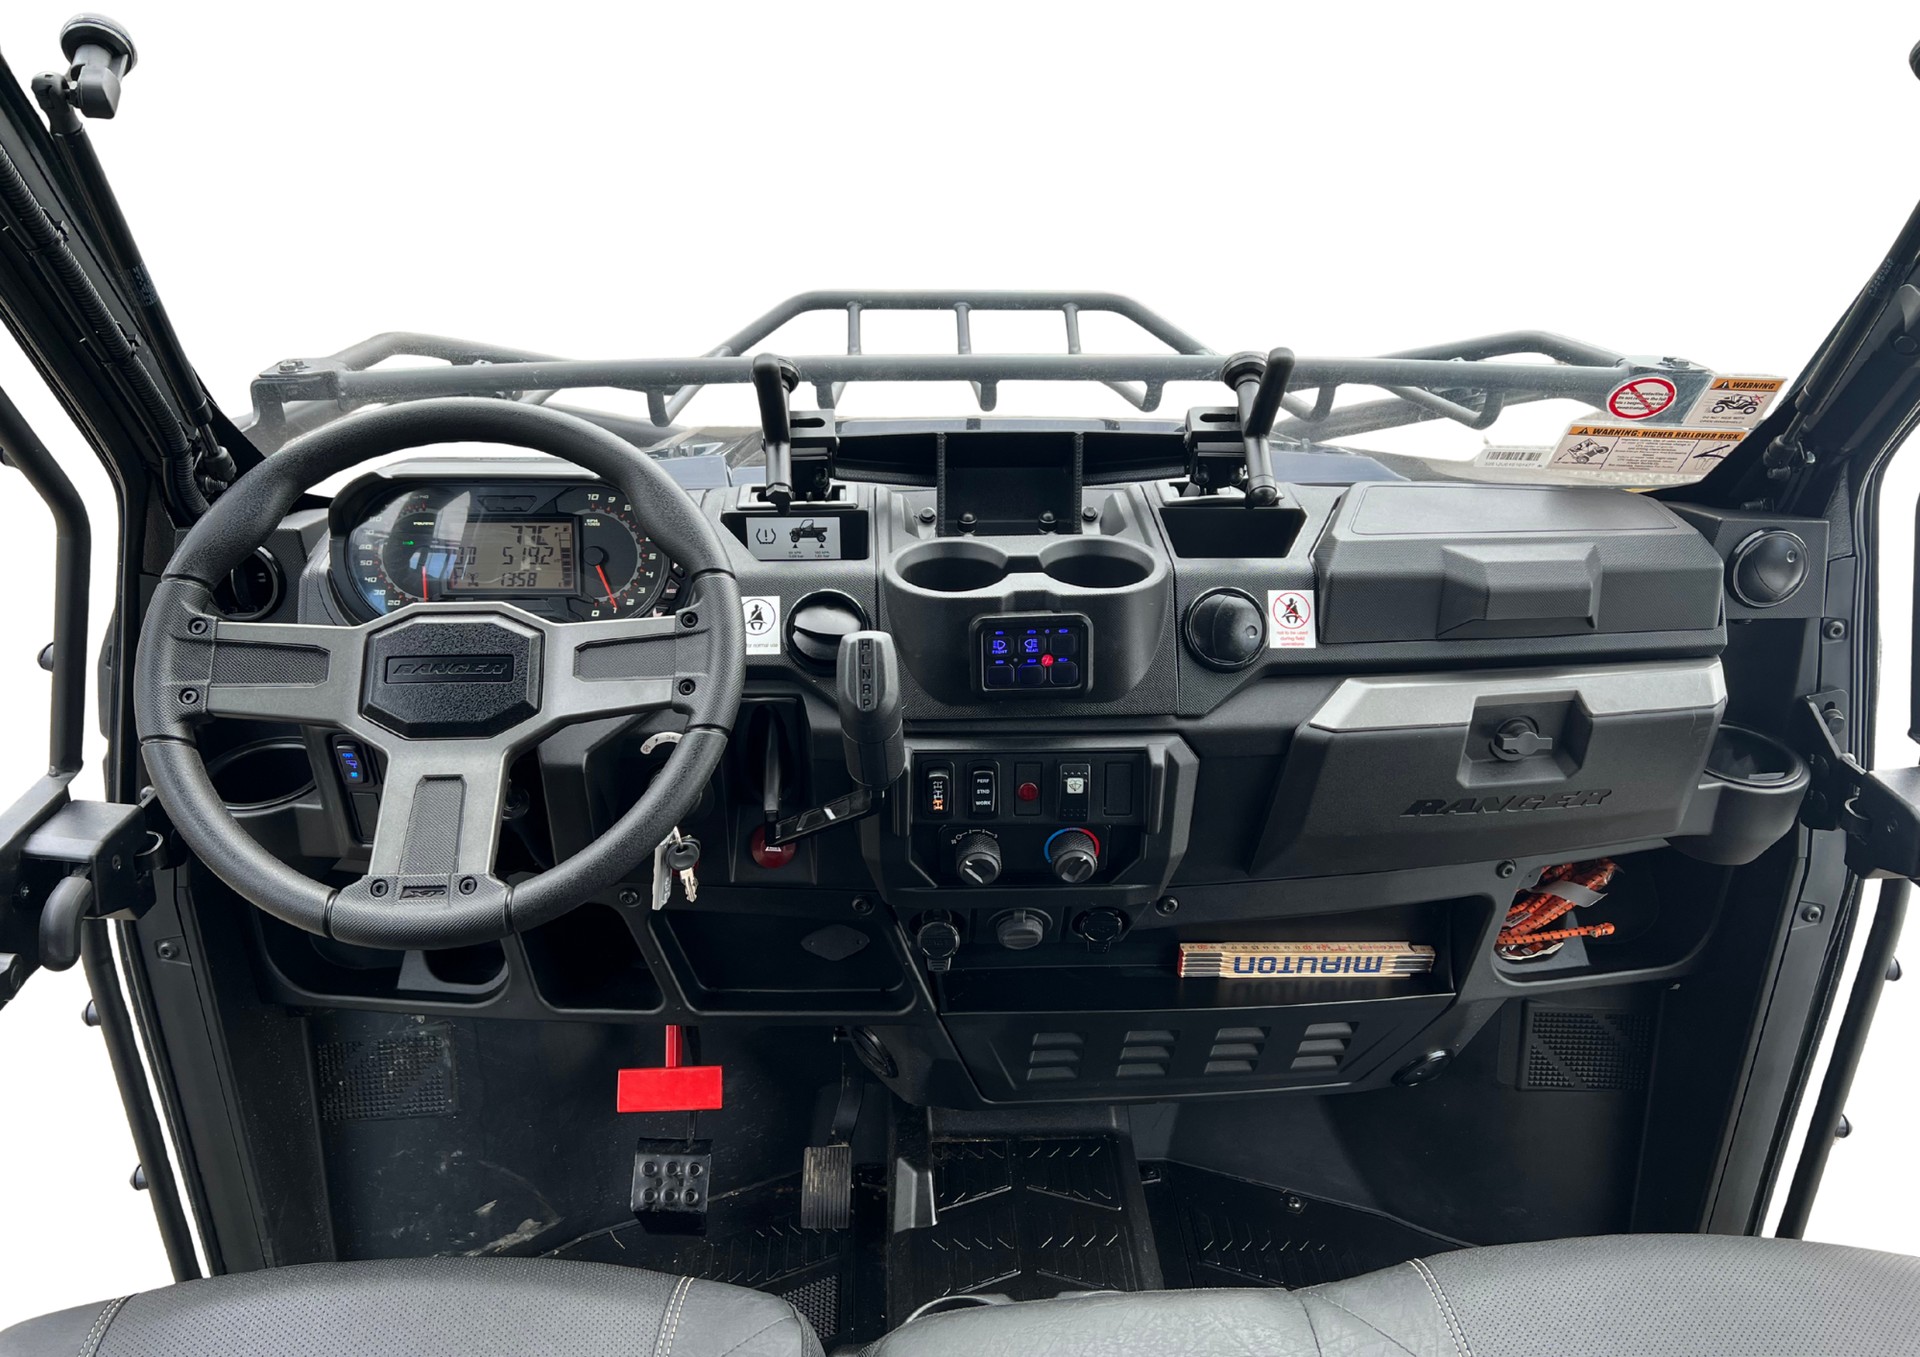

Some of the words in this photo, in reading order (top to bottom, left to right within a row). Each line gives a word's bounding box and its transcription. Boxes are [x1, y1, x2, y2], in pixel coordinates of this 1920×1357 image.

[1593, 428, 1640, 437] WARNING:
[1642, 430, 1673, 438] HIGHER
[1675, 431, 1718, 439] ROLLOVER
[588, 493, 599, 501] 10
[591, 609, 600, 617] 0
[861, 640, 871, 651] H
[861, 654, 869, 665] L
[393, 662, 509, 676] RANGER
[862, 668, 871, 680] N
[862, 683, 872, 695] R
[862, 698, 872, 710] P
[1399, 788, 1613, 818] RANGER
[1233, 956, 1384, 974] MIAUTON
